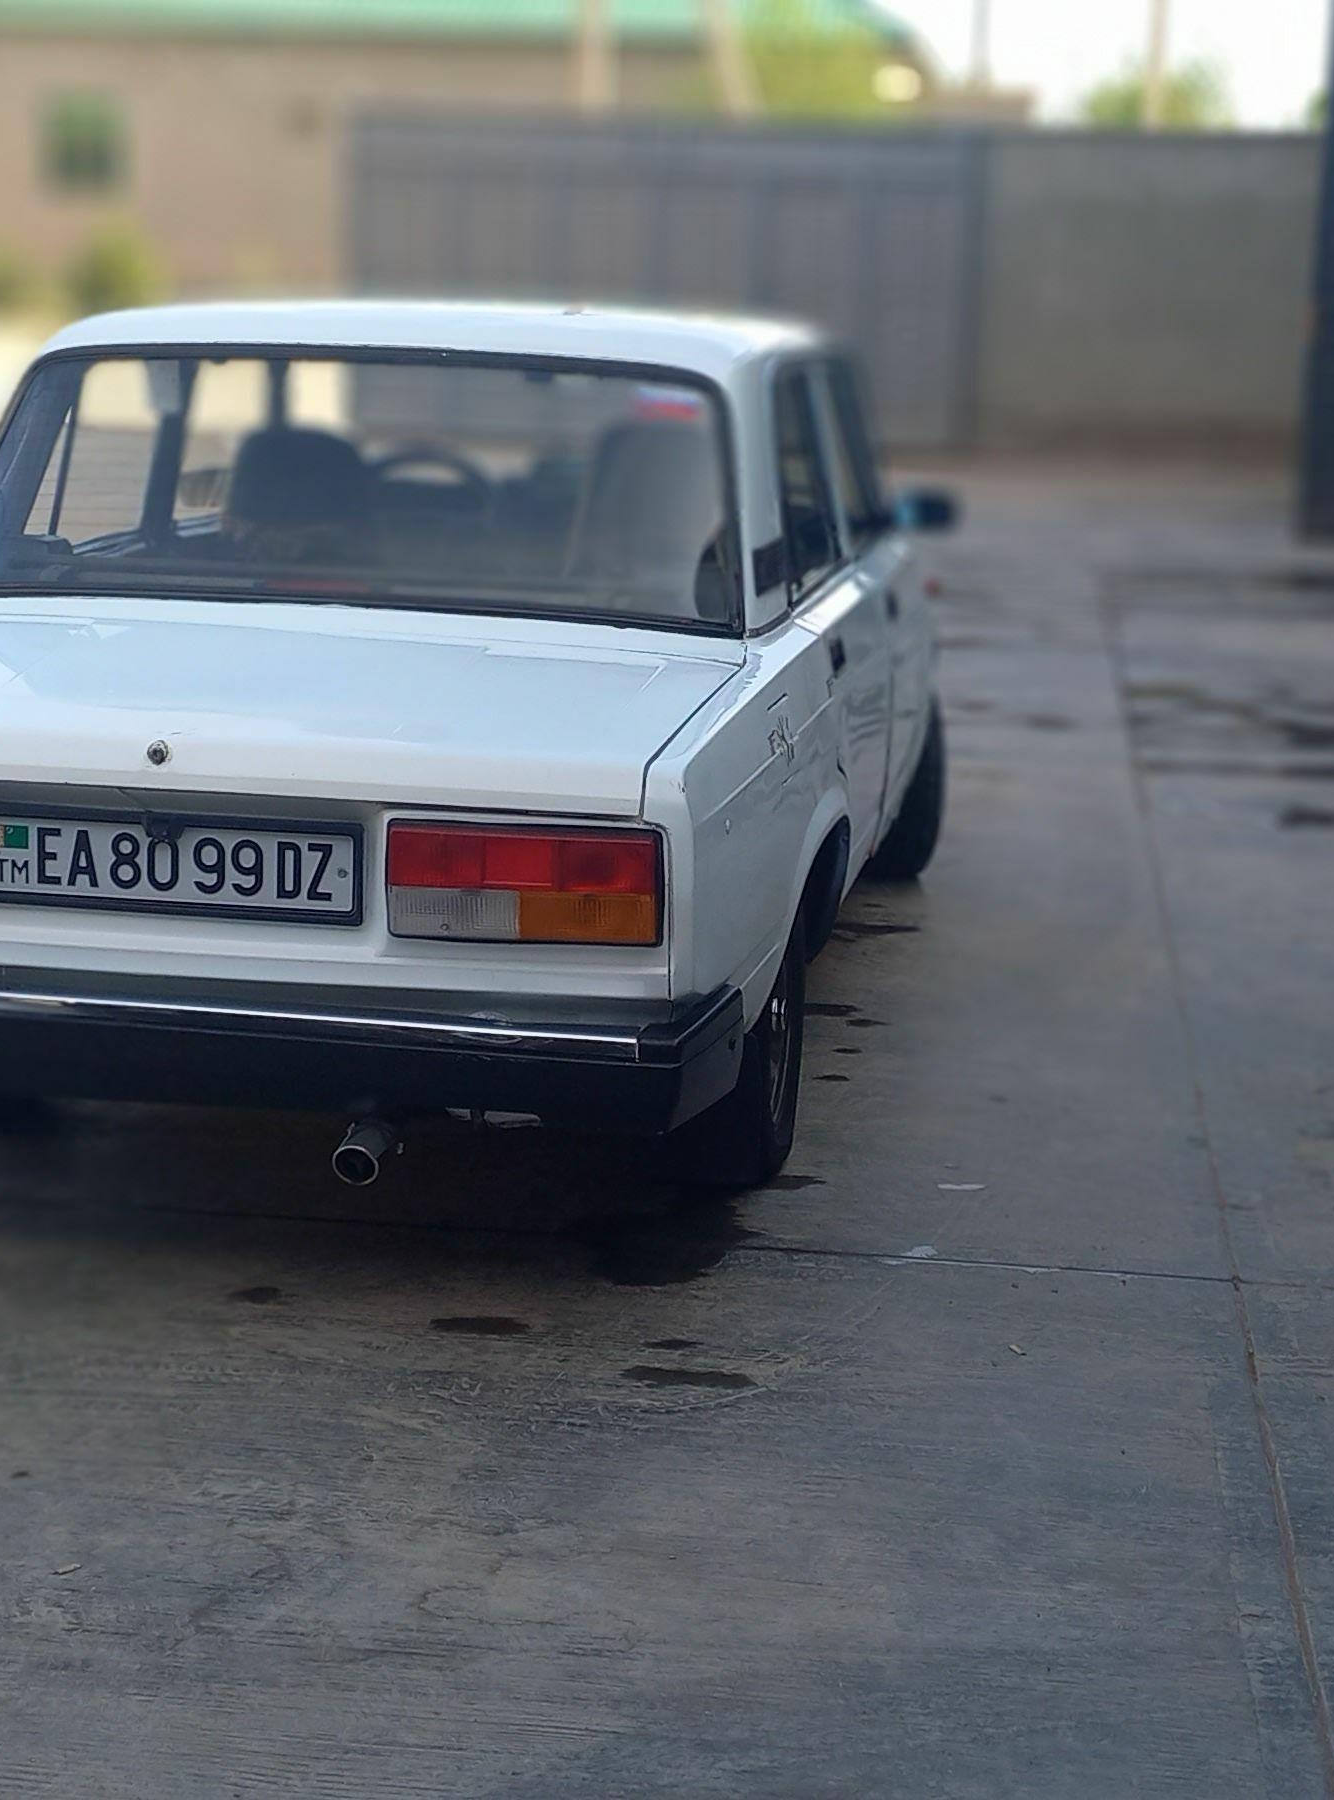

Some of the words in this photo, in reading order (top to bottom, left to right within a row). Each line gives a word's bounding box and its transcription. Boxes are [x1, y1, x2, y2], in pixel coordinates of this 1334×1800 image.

[37, 827, 99, 888] EA
[110, 832, 179, 891] 80
[193, 837, 263, 896] 99
[276, 841, 333, 901] DZ
